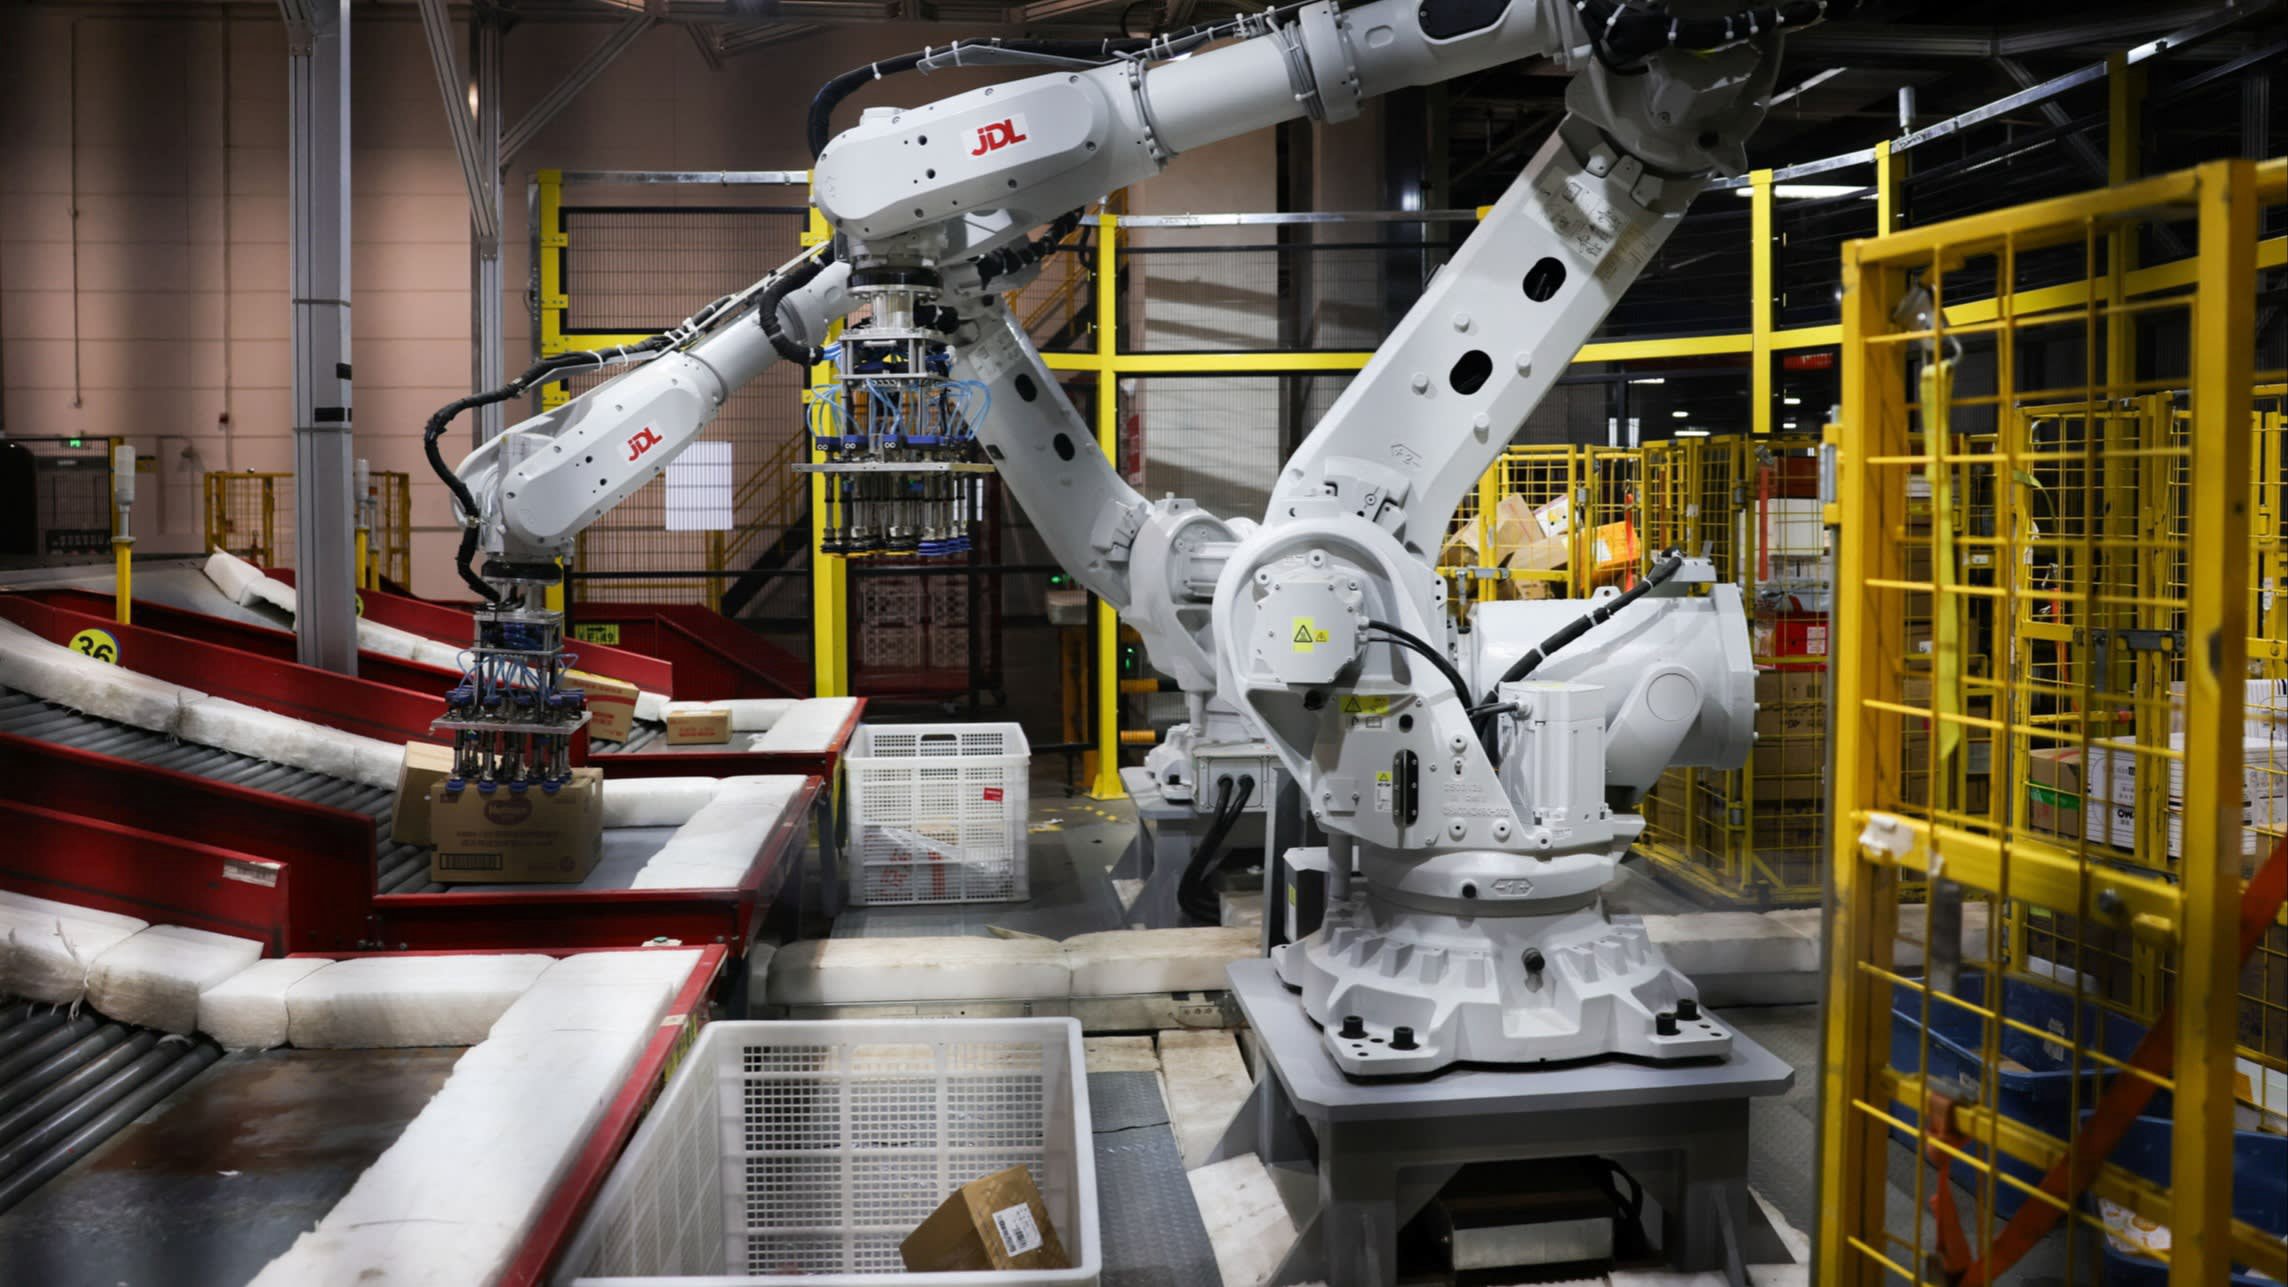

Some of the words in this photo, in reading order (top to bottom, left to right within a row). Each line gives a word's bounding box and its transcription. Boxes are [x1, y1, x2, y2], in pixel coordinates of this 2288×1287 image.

[970, 118, 1026, 156] JDL
[627, 426, 663, 462] JDL
[78, 635, 114, 663] 36
